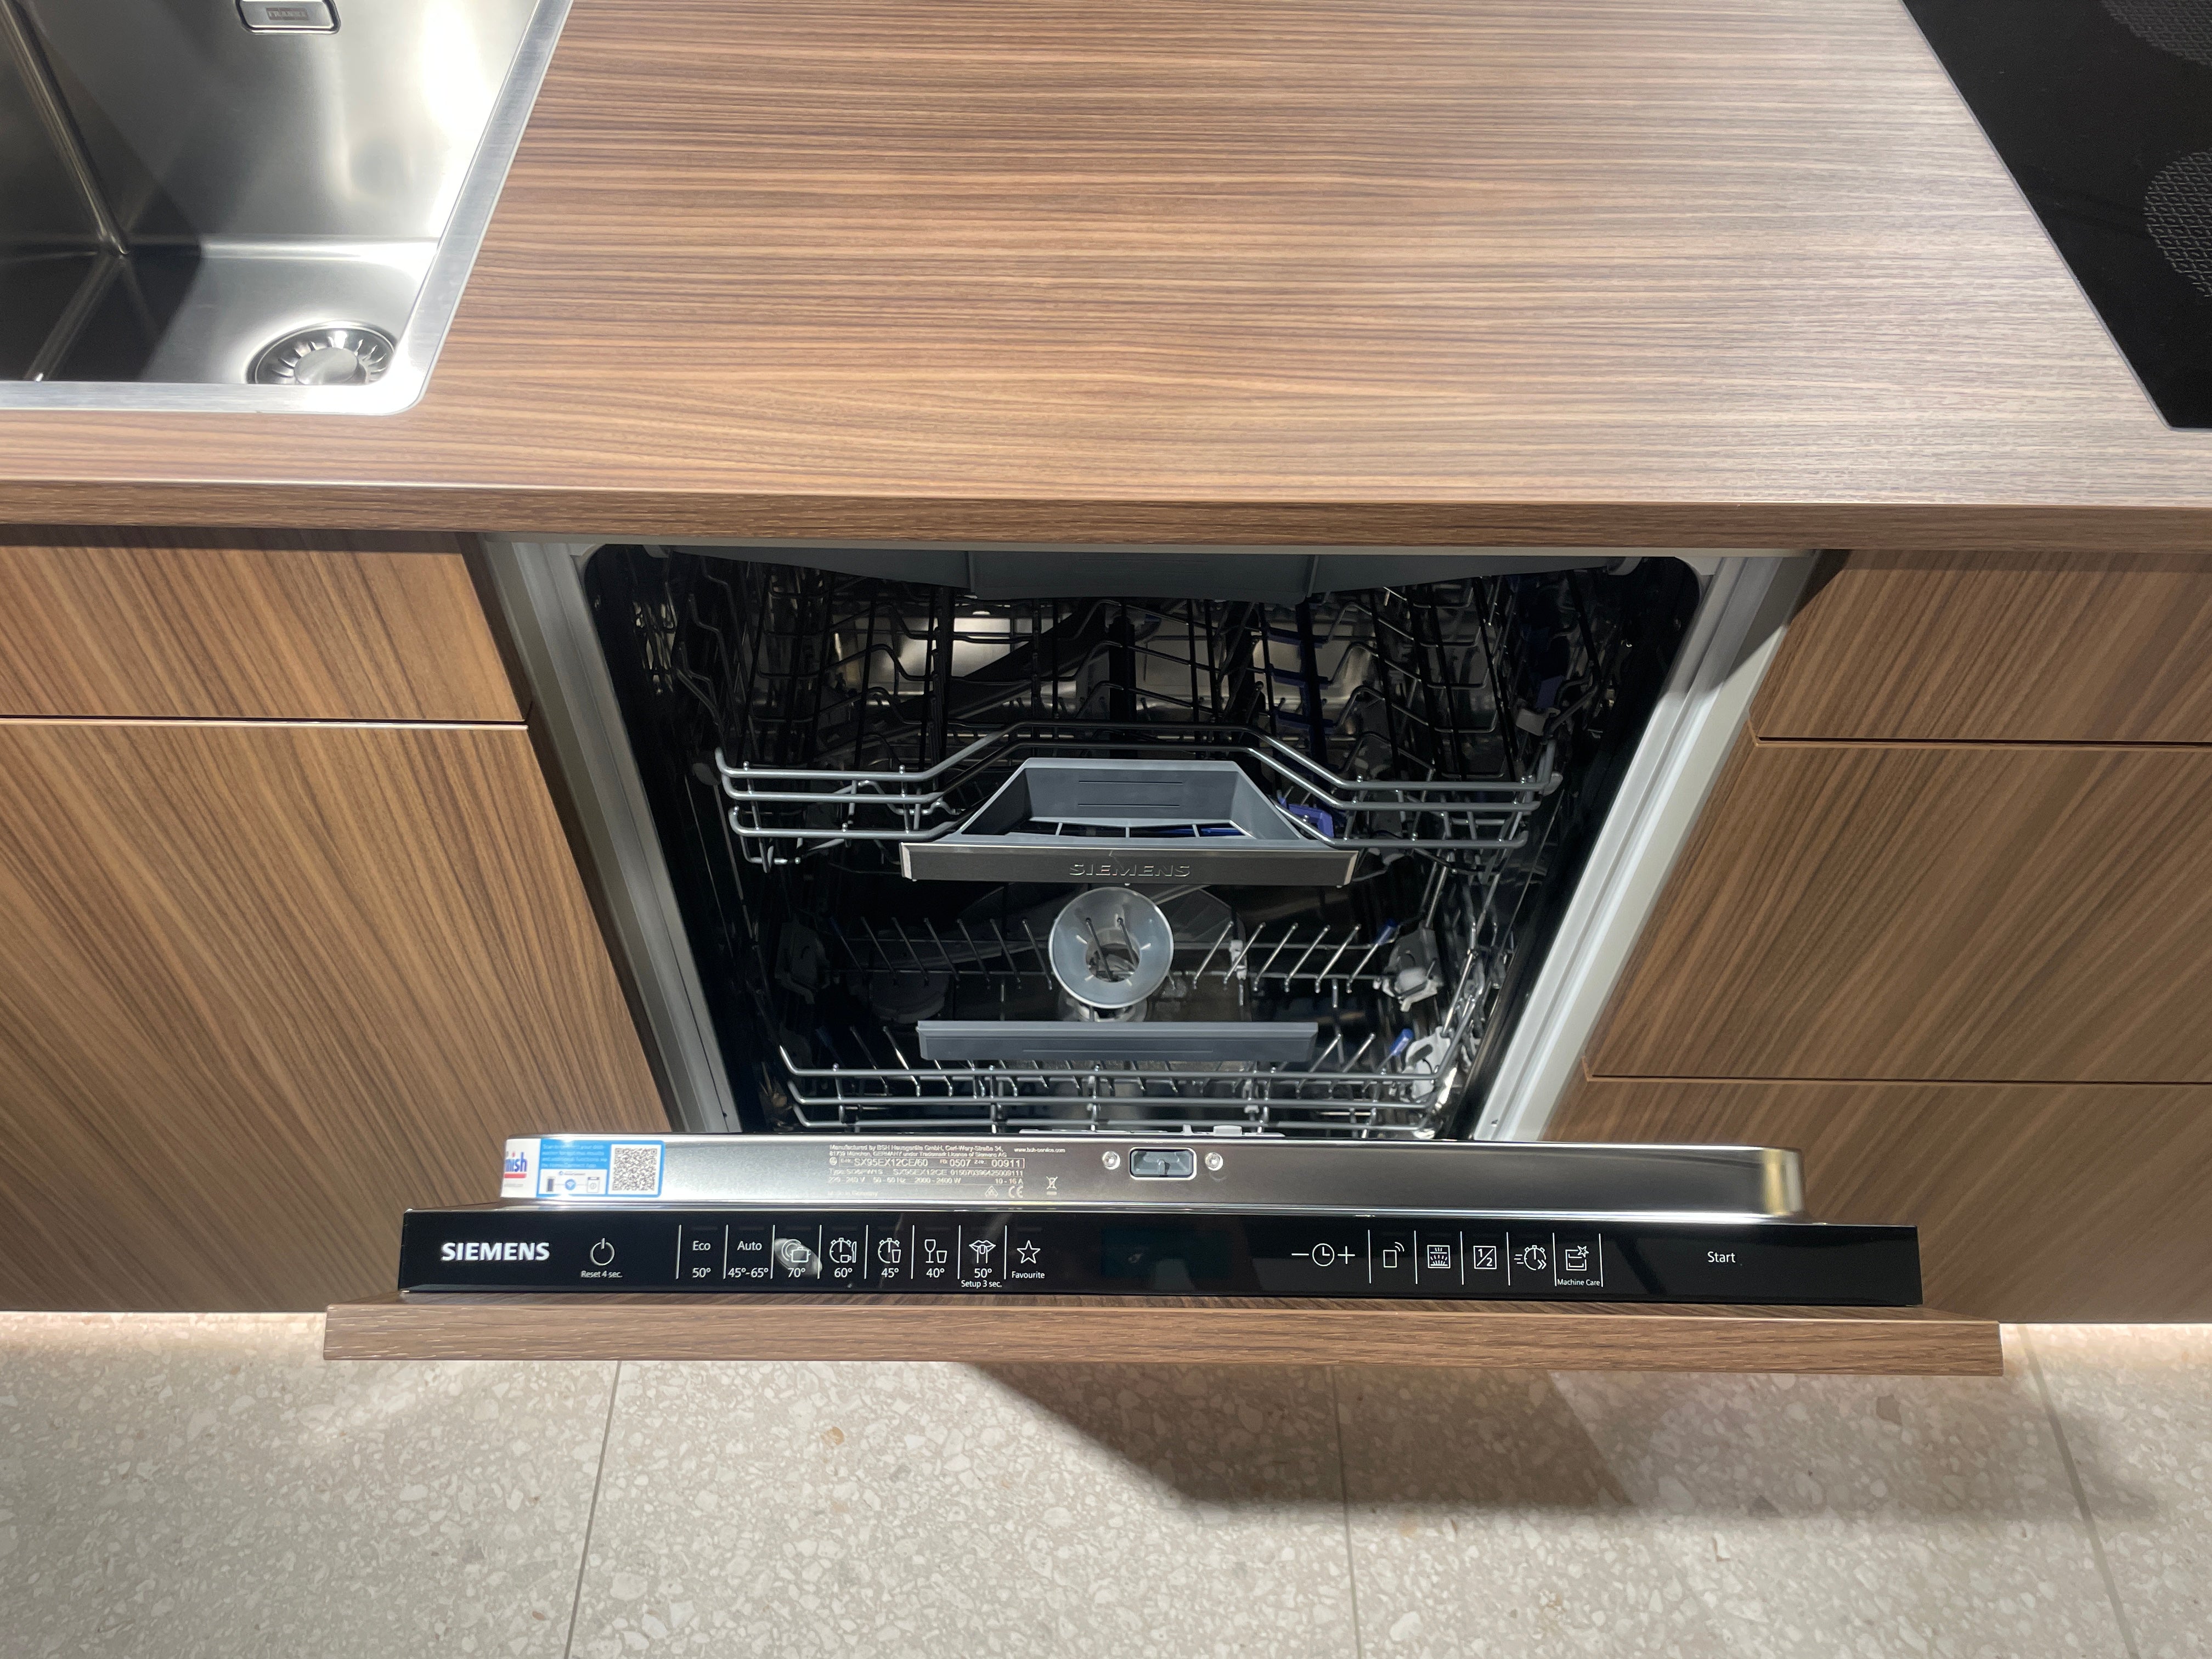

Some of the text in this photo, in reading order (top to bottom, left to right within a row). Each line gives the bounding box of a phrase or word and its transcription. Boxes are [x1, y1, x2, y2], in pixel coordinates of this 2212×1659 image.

[1070, 864, 1190, 877] SIEMENS
[854, 1158, 928, 1166] SX95EX12CE/60
[950, 1159, 971, 1167] 0507
[991, 1159, 1020, 1167] 00911
[692, 1240, 711, 1251] Eco
[737, 1240, 762, 1251] Auto
[441, 1242, 550, 1261] SIEMENS
[1707, 1251, 1736, 1263] Start
[692, 1267, 711, 1278] 50°
[788, 1268, 805, 1278] 70°
[834, 1268, 853, 1278] 60°
[881, 1268, 899, 1278] 45°
[926, 1268, 945, 1278] 40°
[974, 1268, 992, 1278] 50°
[1012, 1271, 1045, 1279] Favourite
[961, 1280, 981, 1289] Setup
